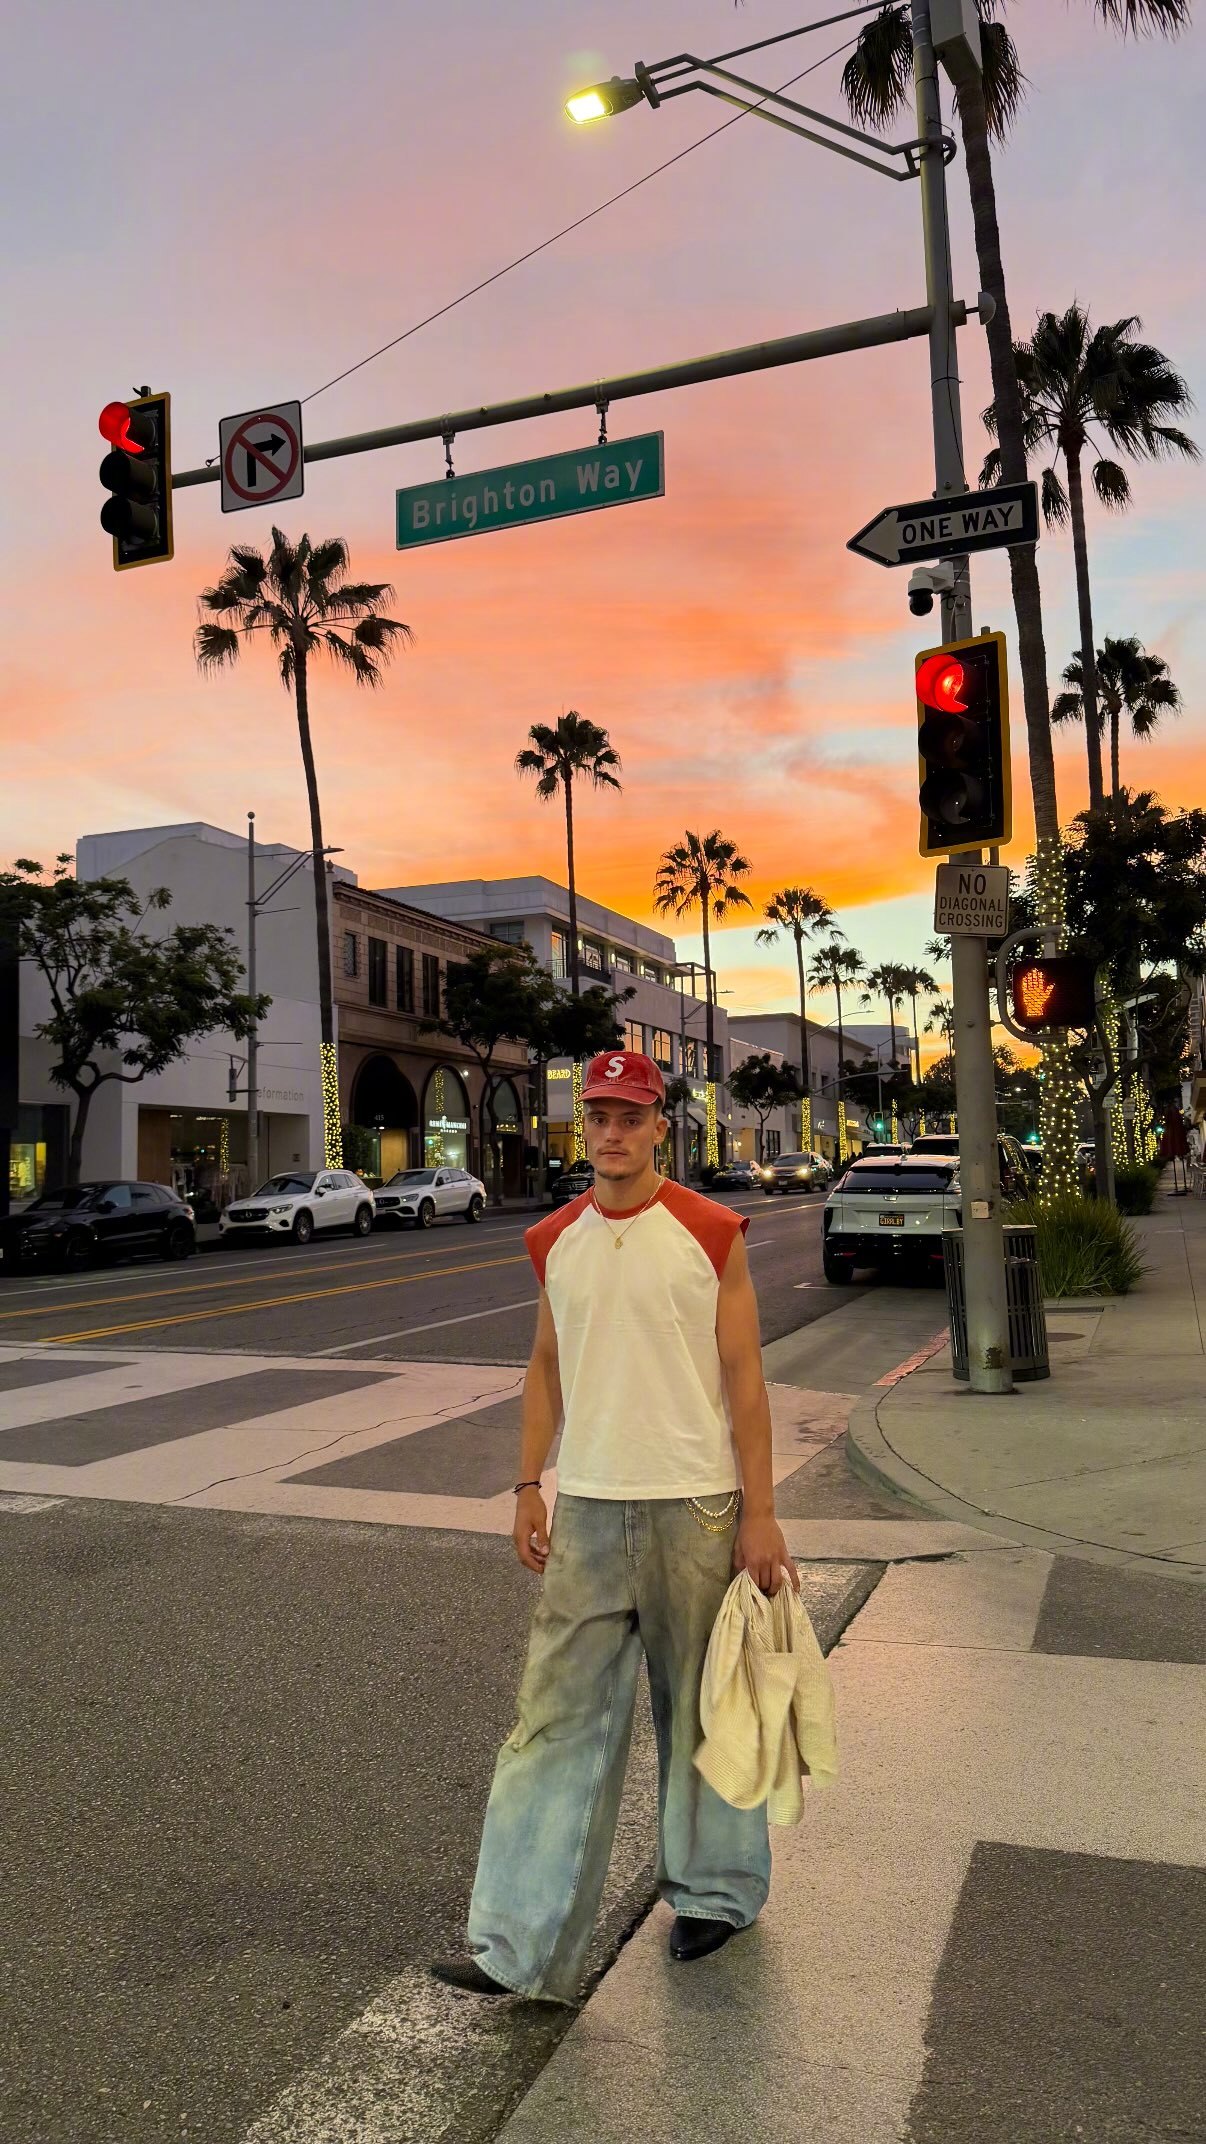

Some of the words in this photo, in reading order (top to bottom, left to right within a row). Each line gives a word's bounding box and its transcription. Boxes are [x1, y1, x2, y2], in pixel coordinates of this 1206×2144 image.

[412, 479, 556, 529] Brighton
[576, 459, 643, 494] Way
[902, 517, 953, 545] ONE
[961, 505, 1014, 534] WAY
[959, 873, 987, 895] NO
[940, 897, 1004, 911] DIAGONAL
[939, 913, 1003, 928] CROSSING
[604, 1056, 627, 1078] S
[257, 1087, 304, 1101] eformation
